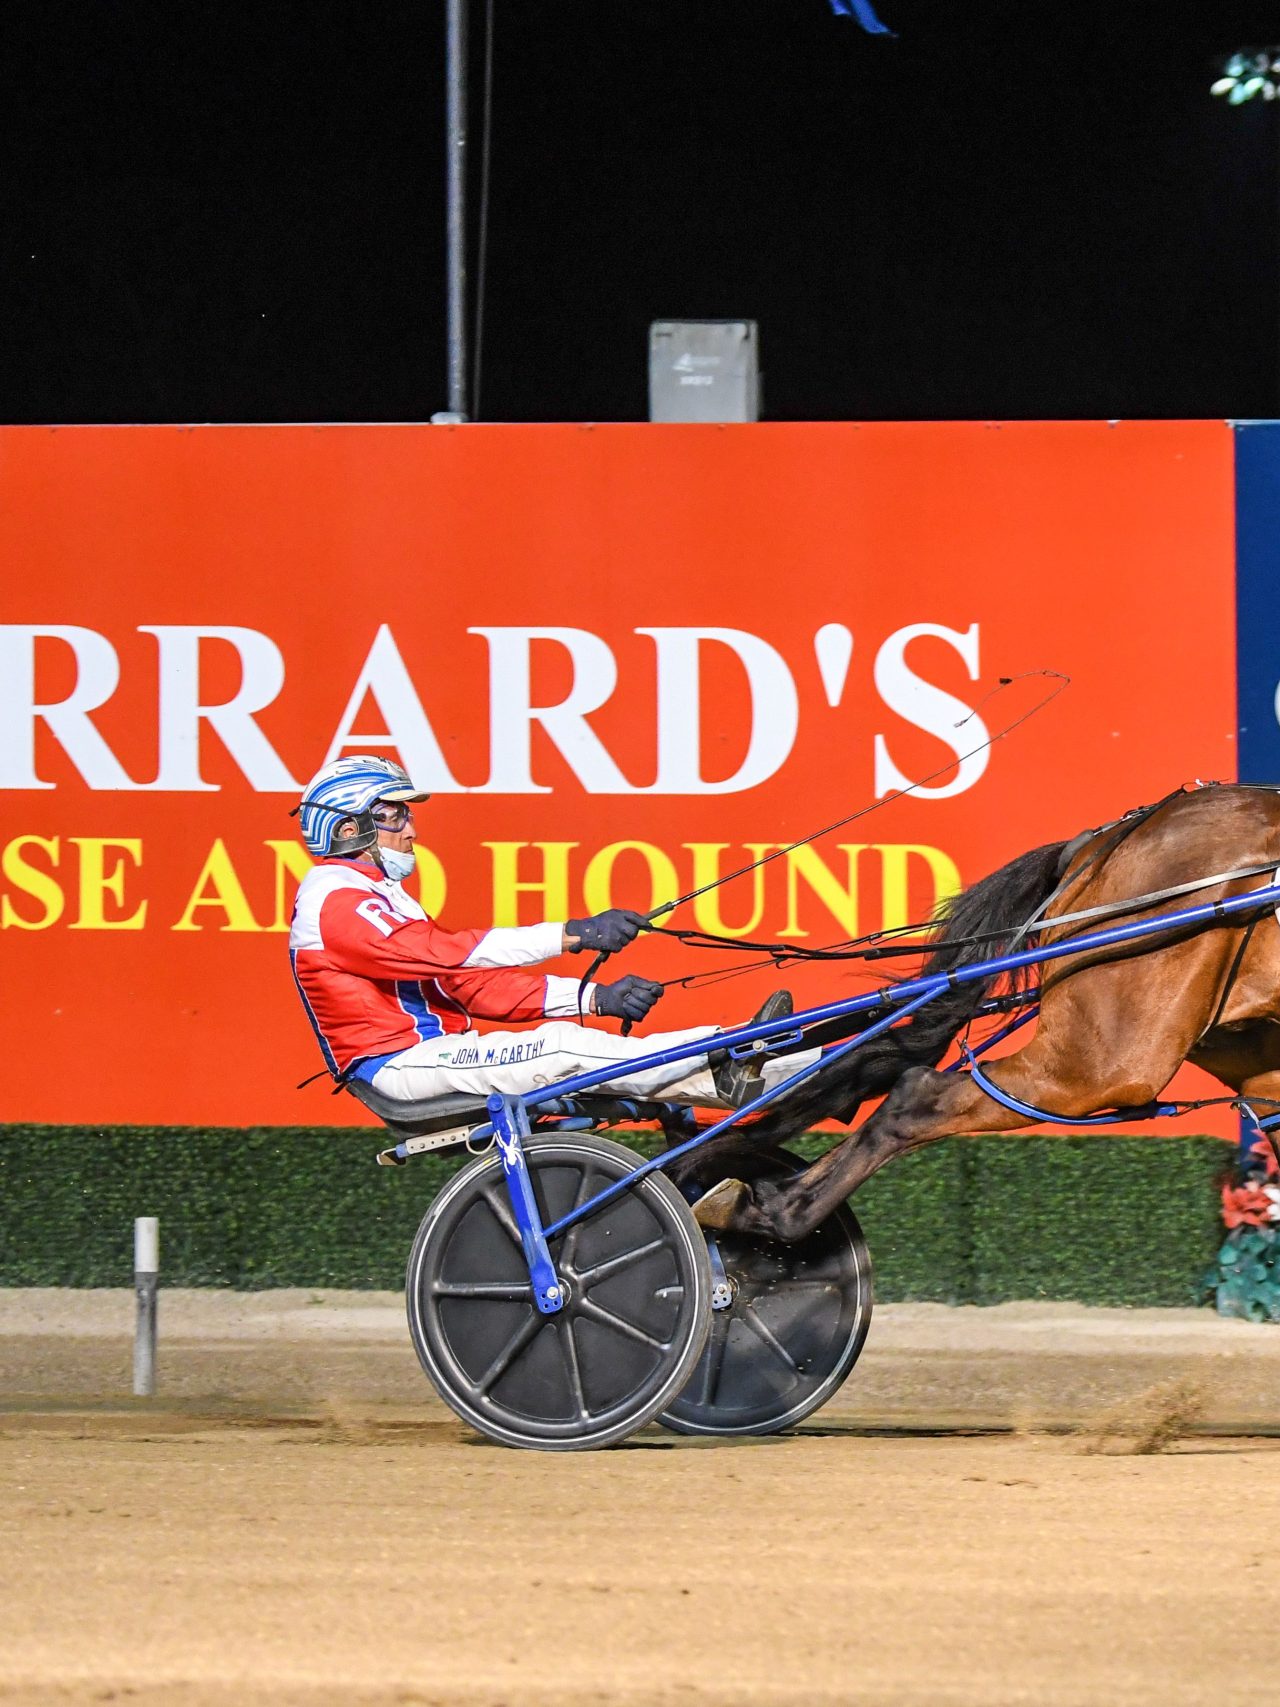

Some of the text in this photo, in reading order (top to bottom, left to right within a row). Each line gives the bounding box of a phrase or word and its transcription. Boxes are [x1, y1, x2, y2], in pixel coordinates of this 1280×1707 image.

[0, 622, 991, 799] RRARD'S
[2, 834, 148, 931] SE
[480, 840, 963, 939] HOUND
[451, 1047, 479, 1065] JOHN
